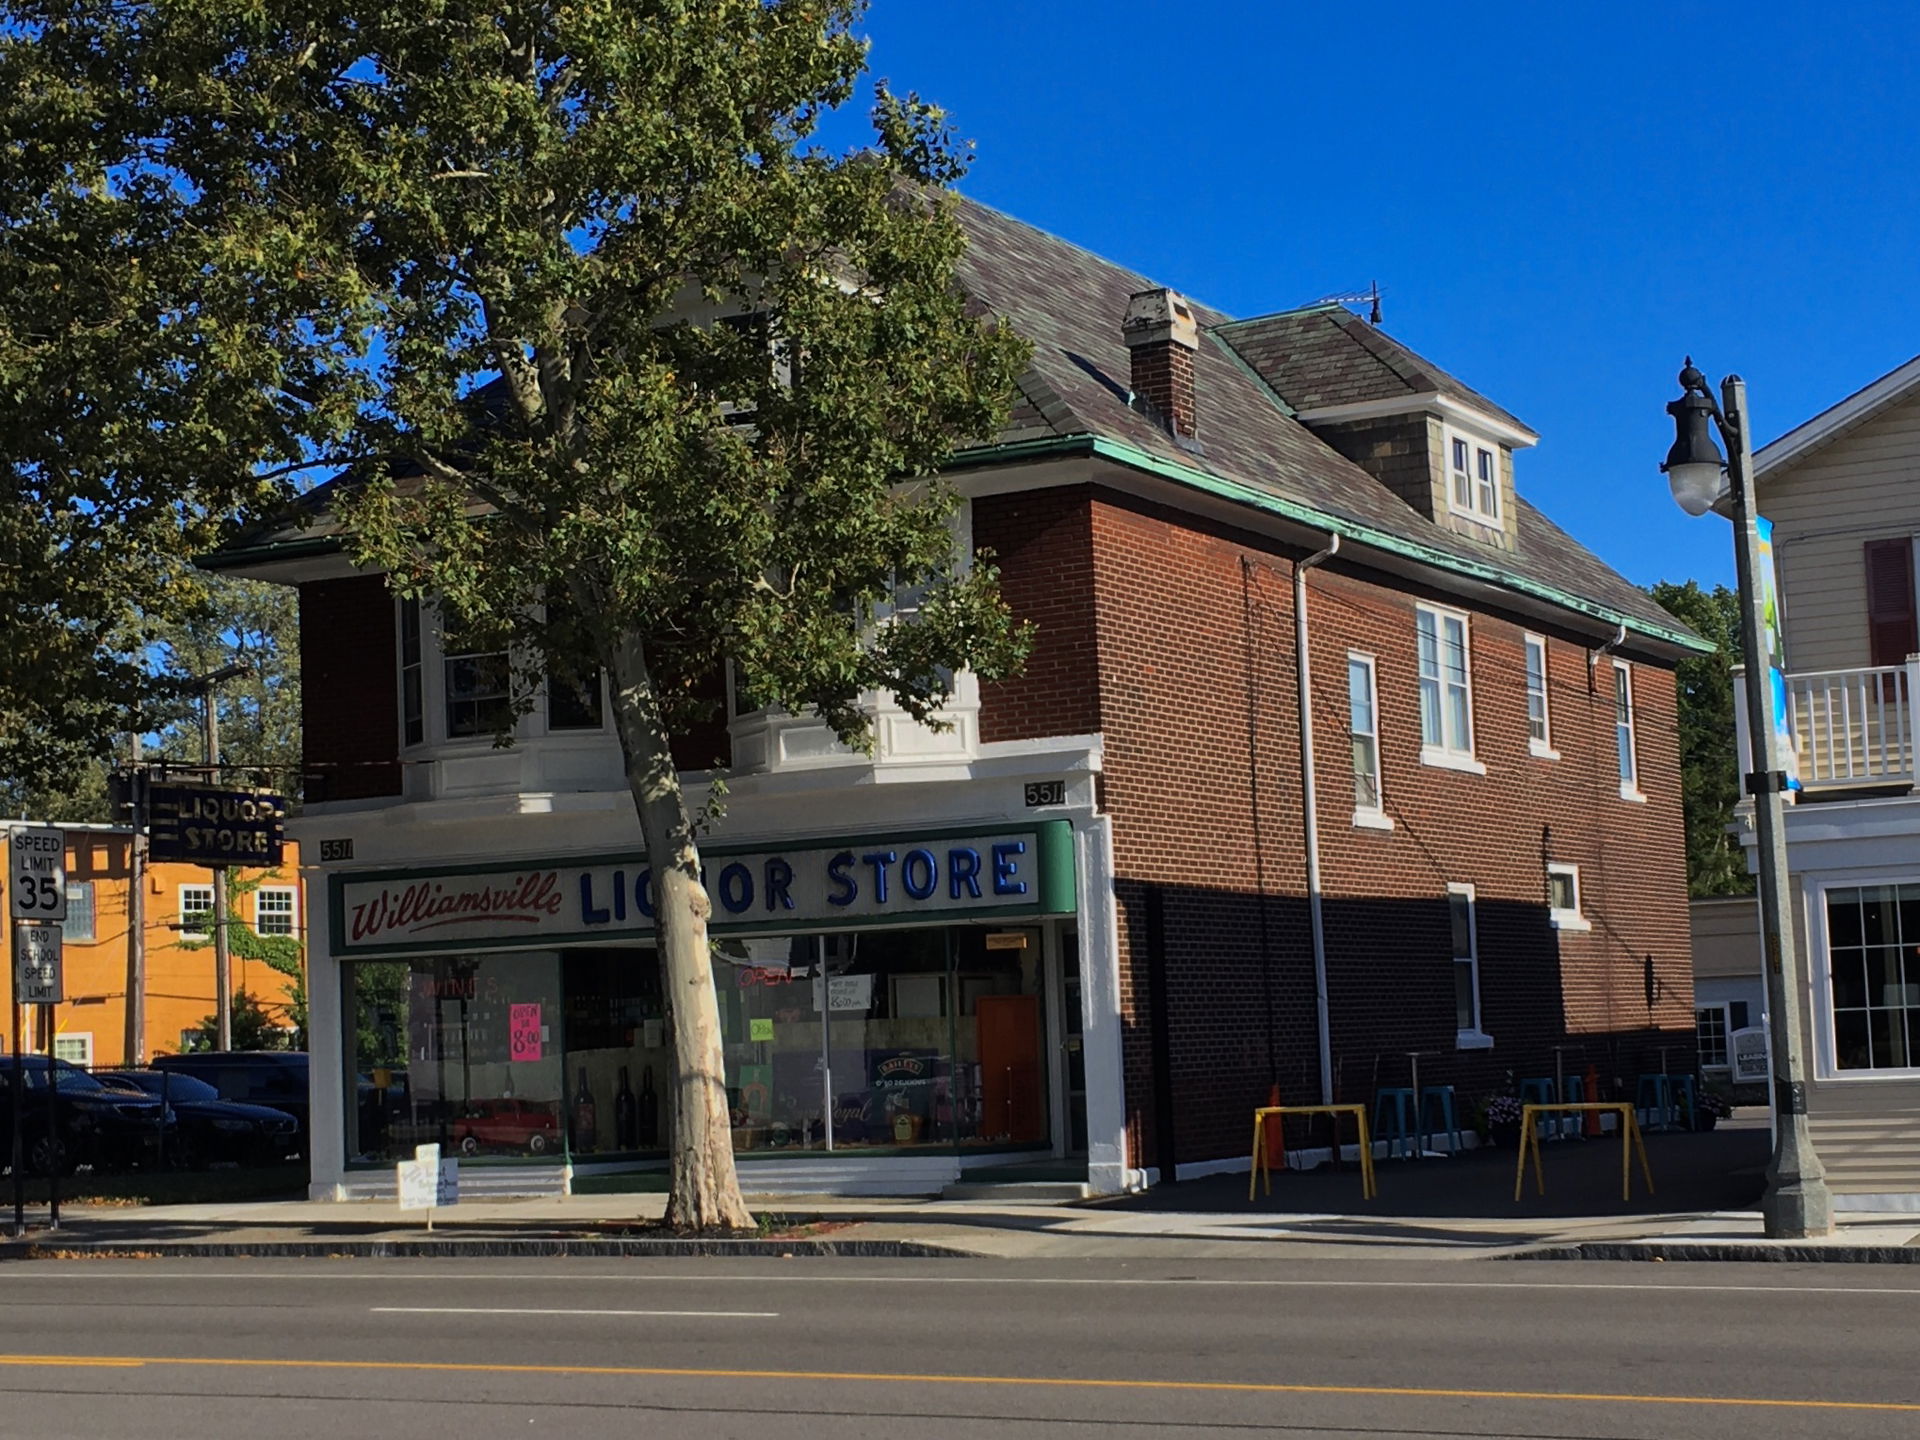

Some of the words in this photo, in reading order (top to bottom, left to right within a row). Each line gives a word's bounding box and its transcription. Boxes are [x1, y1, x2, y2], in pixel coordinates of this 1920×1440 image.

[179, 796, 275, 824] LIQUOR
[15, 835, 60, 852] SPEED
[185, 827, 268, 852] STORE
[21, 856, 53, 870] LIMIT
[18, 876, 58, 910] 35
[352, 872, 562, 940] Williamsville
[827, 841, 1026, 906] STORE
[30, 931, 49, 943] END
[20, 950, 59, 961] SCHOOL
[25, 967, 55, 981] SPEED
[28, 986, 53, 998] LIMIT
